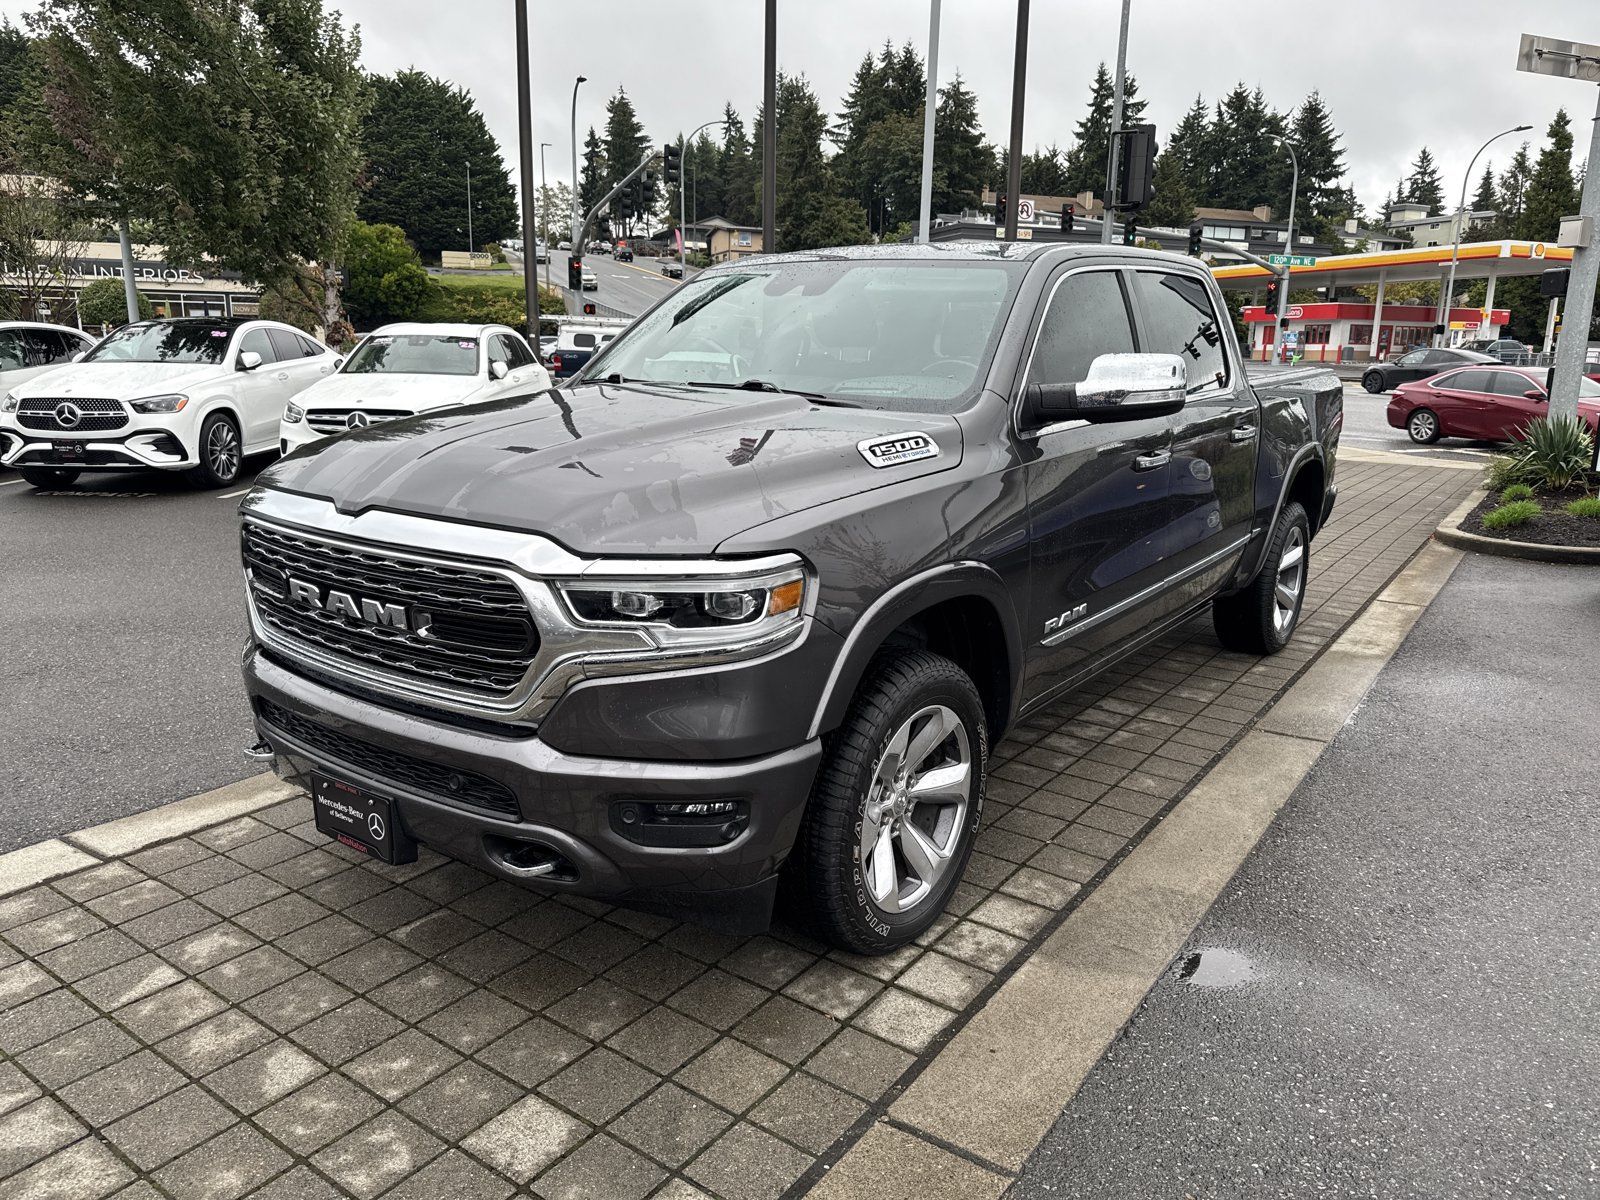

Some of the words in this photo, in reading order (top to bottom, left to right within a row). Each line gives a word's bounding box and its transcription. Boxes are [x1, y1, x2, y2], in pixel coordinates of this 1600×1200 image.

[1274, 256, 1287, 264] 120th
[1290, 257, 1300, 265] Ave
[1304, 257, 1312, 266] NE
[871, 438, 926, 457] 1500
[881, 454, 902, 463] HEMI
[289, 578, 408, 631] RAM
[1044, 603, 1087, 634] RAM
[318, 794, 364, 820] Mercedes-Benz
[337, 834, 368, 854] AutoNation
[853, 793, 891, 937] WILDPEAK
